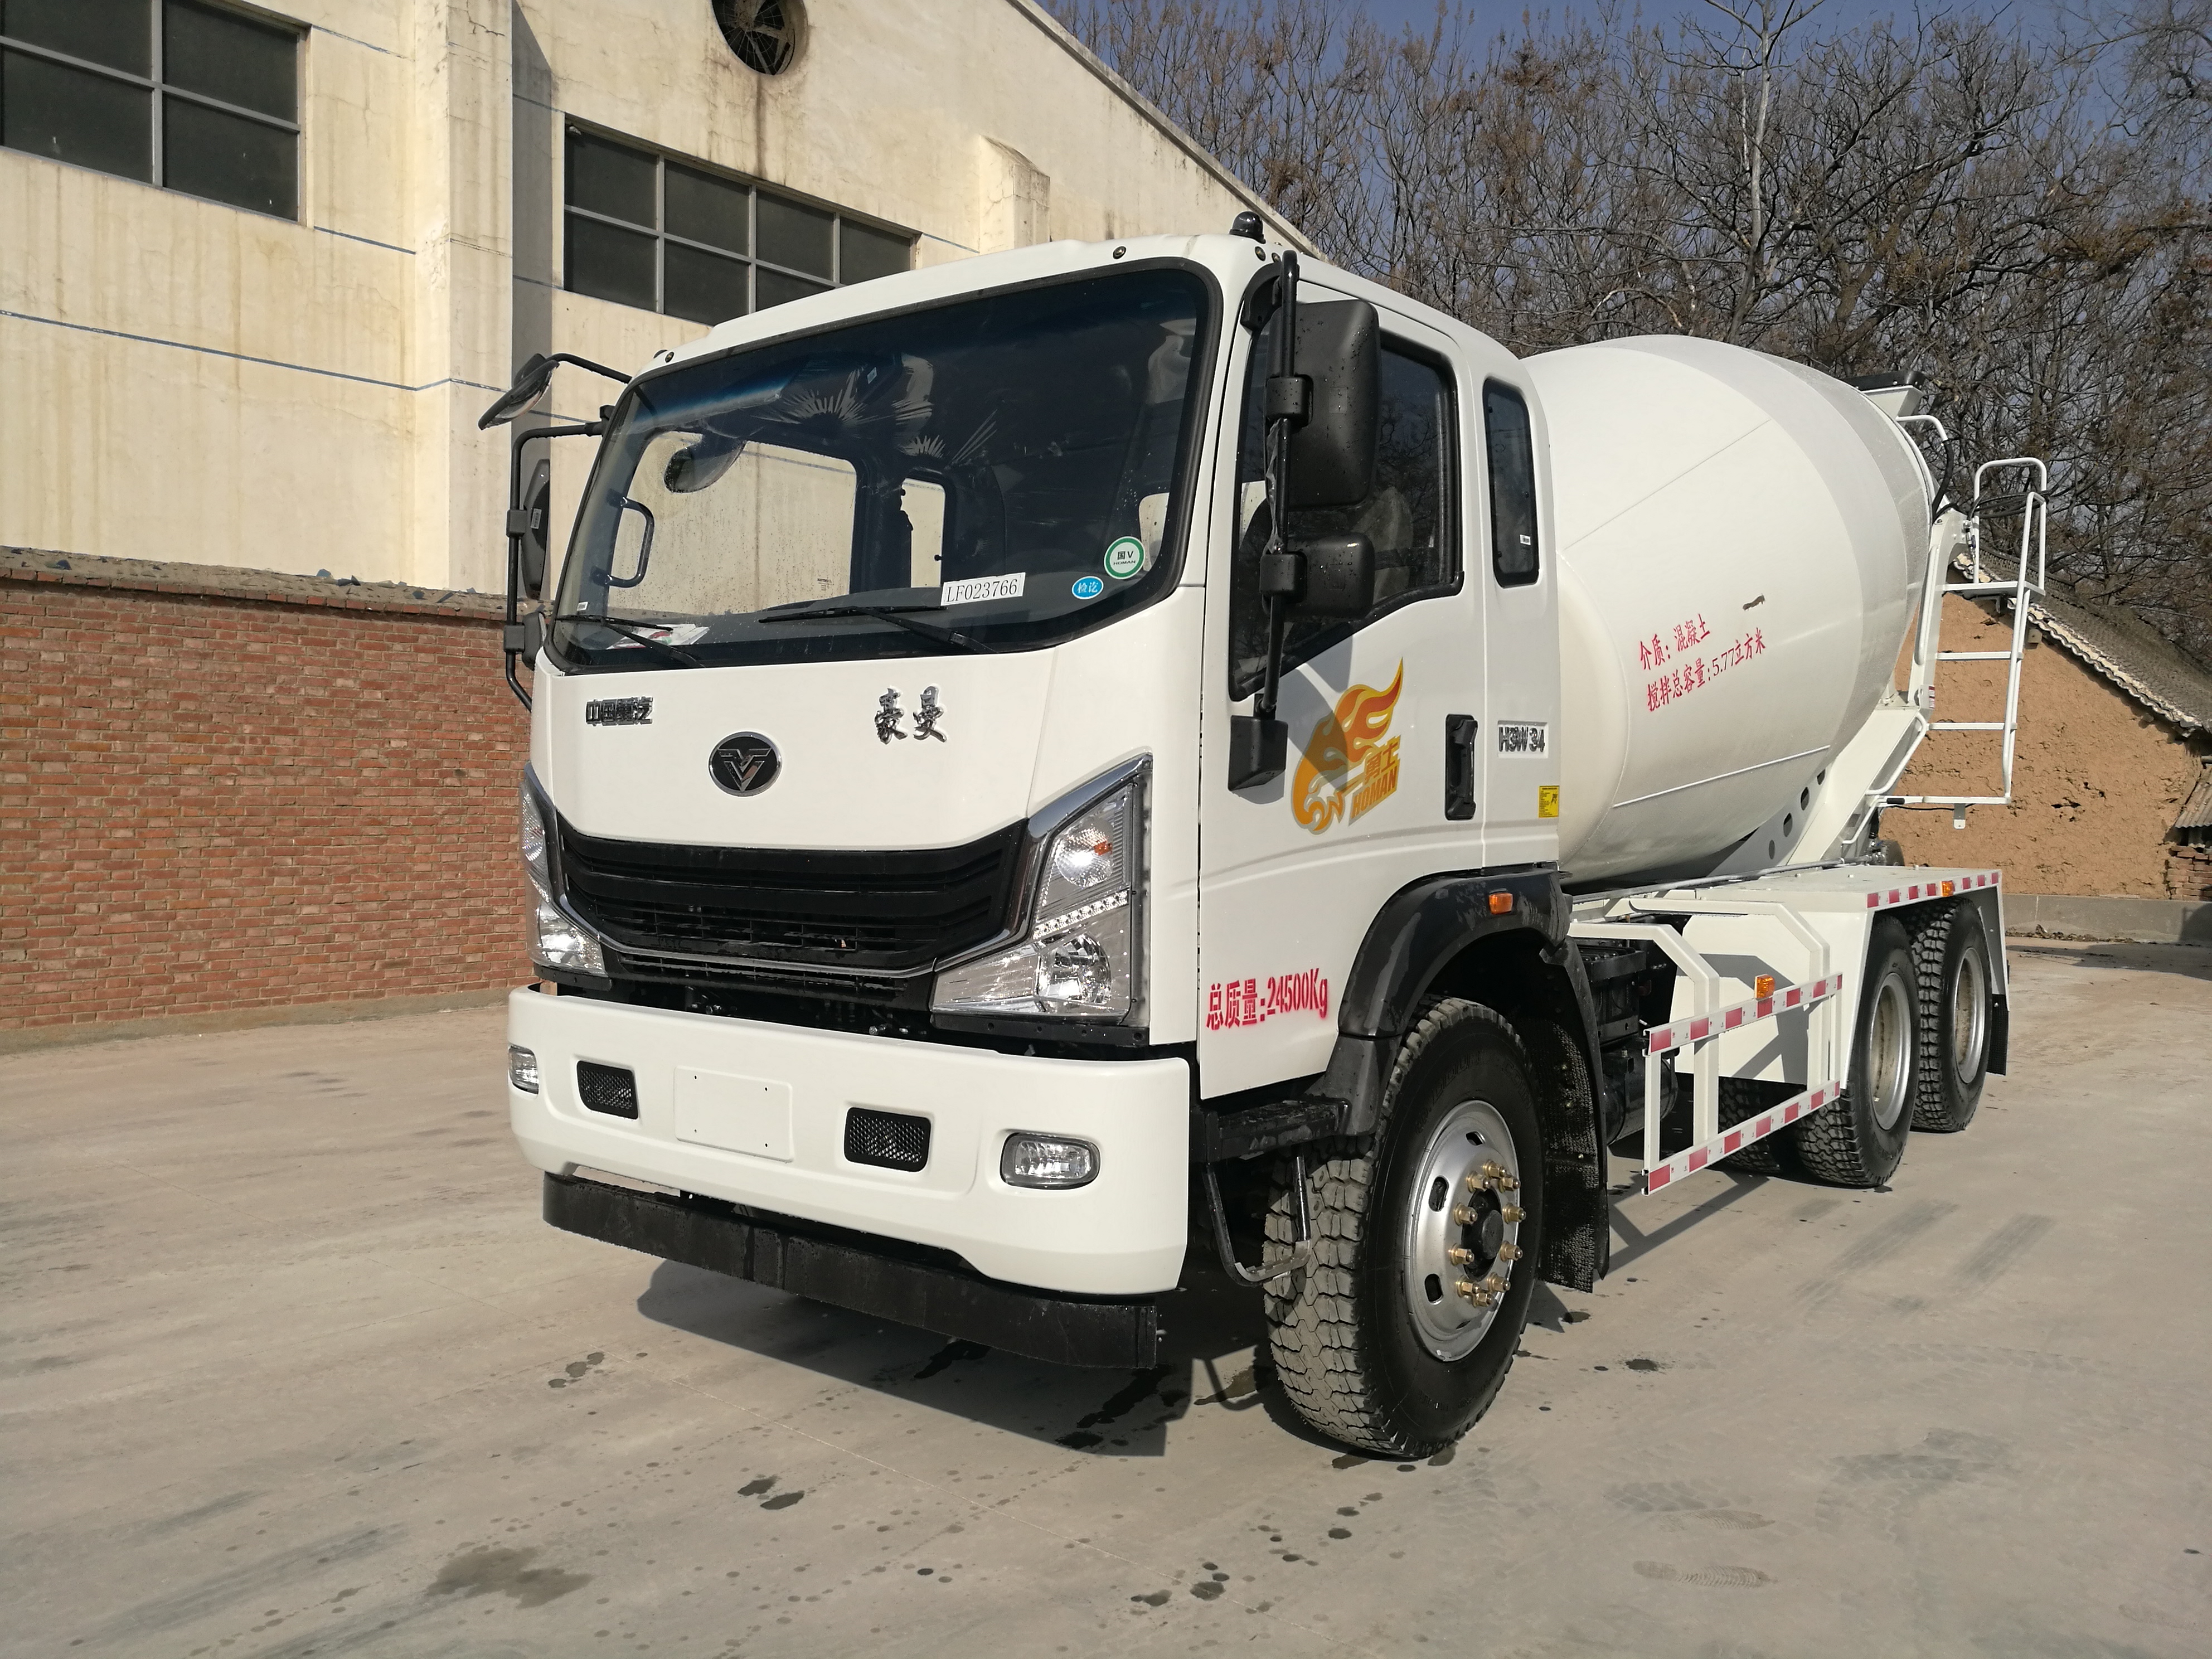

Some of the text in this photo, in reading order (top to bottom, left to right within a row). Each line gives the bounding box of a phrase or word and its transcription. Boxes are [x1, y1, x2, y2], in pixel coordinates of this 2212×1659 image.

[946, 578, 1018, 603] LF023766
[1077, 581, 1099, 594] 检讫
[1350, 764, 1398, 820] HOMAN
